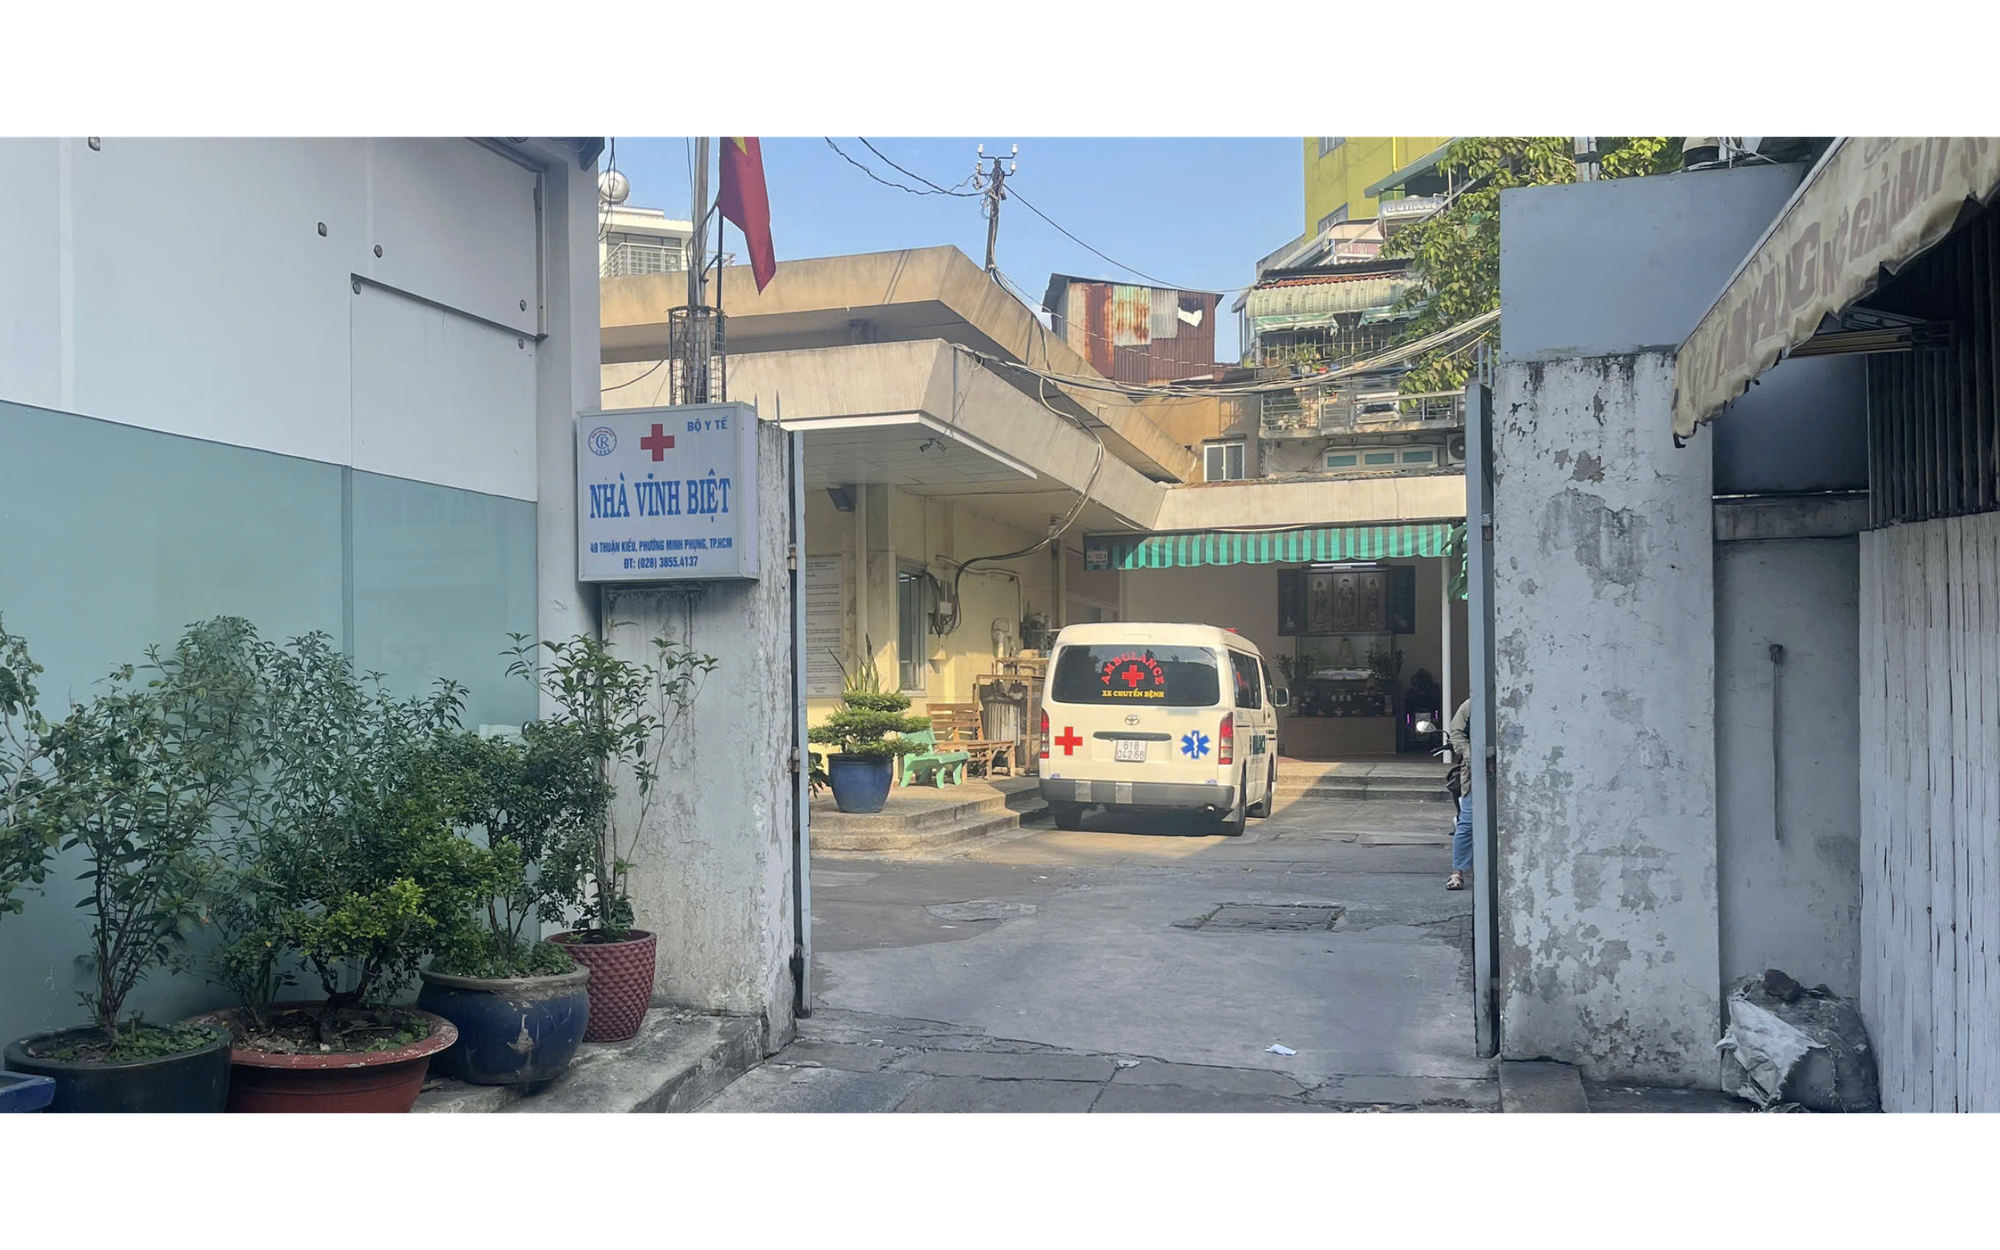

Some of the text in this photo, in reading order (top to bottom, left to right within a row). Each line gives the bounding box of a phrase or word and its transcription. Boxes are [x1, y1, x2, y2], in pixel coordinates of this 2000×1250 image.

[687, 415, 729, 433] BỘ Y TẾ
[590, 472, 630, 519] NHÀ
[686, 468, 731, 523] BIỆT
[590, 542, 598, 553] 49
[599, 539, 620, 555] THUẬN
[666, 539, 683, 550] MINH
[710, 537, 733, 549] TP.HCM
[637, 557, 657, 569] (028)
[659, 556, 698, 568] 3855.4137
[1101, 651, 1165, 685] AMBULANCE
[1144, 690, 1165, 699] BỆNH
